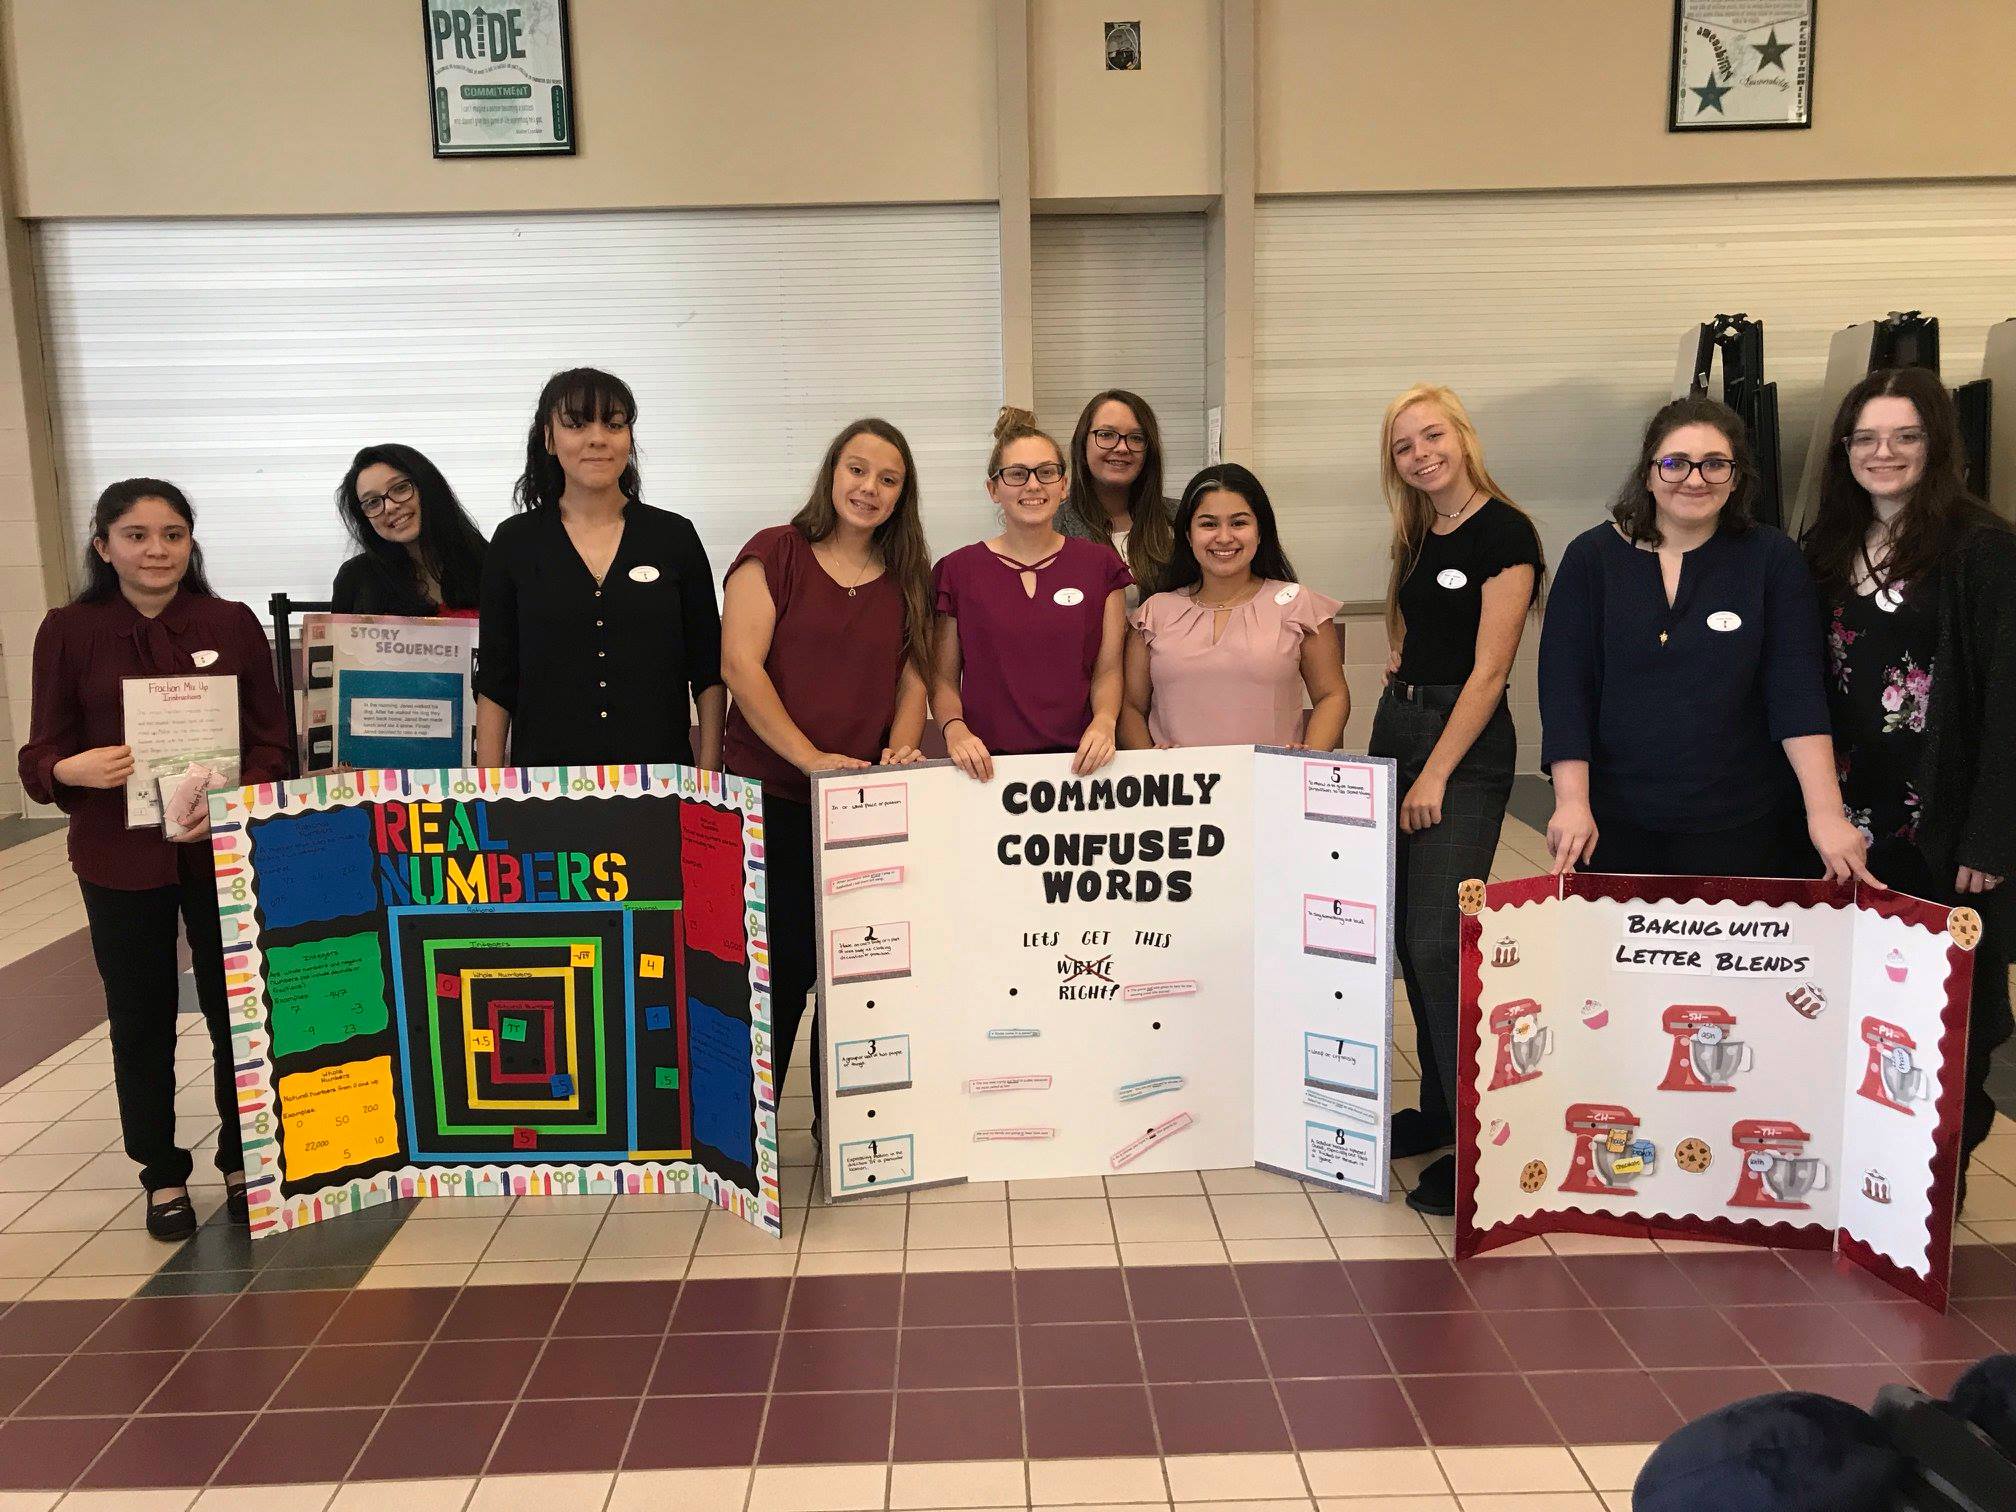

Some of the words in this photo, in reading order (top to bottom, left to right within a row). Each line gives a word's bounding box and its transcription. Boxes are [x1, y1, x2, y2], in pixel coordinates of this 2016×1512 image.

[432, 6, 526, 62] PRIDE
[464, 86, 529, 97] COMMITMENT
[350, 627, 400, 640] STORY
[376, 642, 459, 657] SEQUENCE!
[1331, 767, 1340, 783] 5
[858, 788, 864, 803] 1
[1002, 773, 1221, 815] COMMONLY
[374, 801, 509, 853] REAL
[998, 824, 1225, 867] CONFUSED
[380, 852, 629, 904] NUMBERS
[1042, 869, 1193, 904] WORDS
[1333, 900, 1342, 915] 6
[864, 926, 878, 941] 2
[1627, 914, 1723, 937] BAKING
[1728, 920, 1790, 938] WITH
[1081, 930, 1111, 946] GET
[1134, 930, 1172, 948] THIS
[648, 960, 654, 970] 4
[1615, 945, 1702, 968] LETTER
[1715, 952, 1810, 972] BLENDS
[443, 980, 452, 991] 0
[344, 1024, 356, 1034] 23
[867, 1039, 876, 1055] 3
[336, 1115, 350, 1127] 50
[520, 1132, 529, 1143] 5
[1335, 1129, 1345, 1145] 8
[343, 1149, 351, 1159] 5
[868, 1140, 878, 1155] 4
